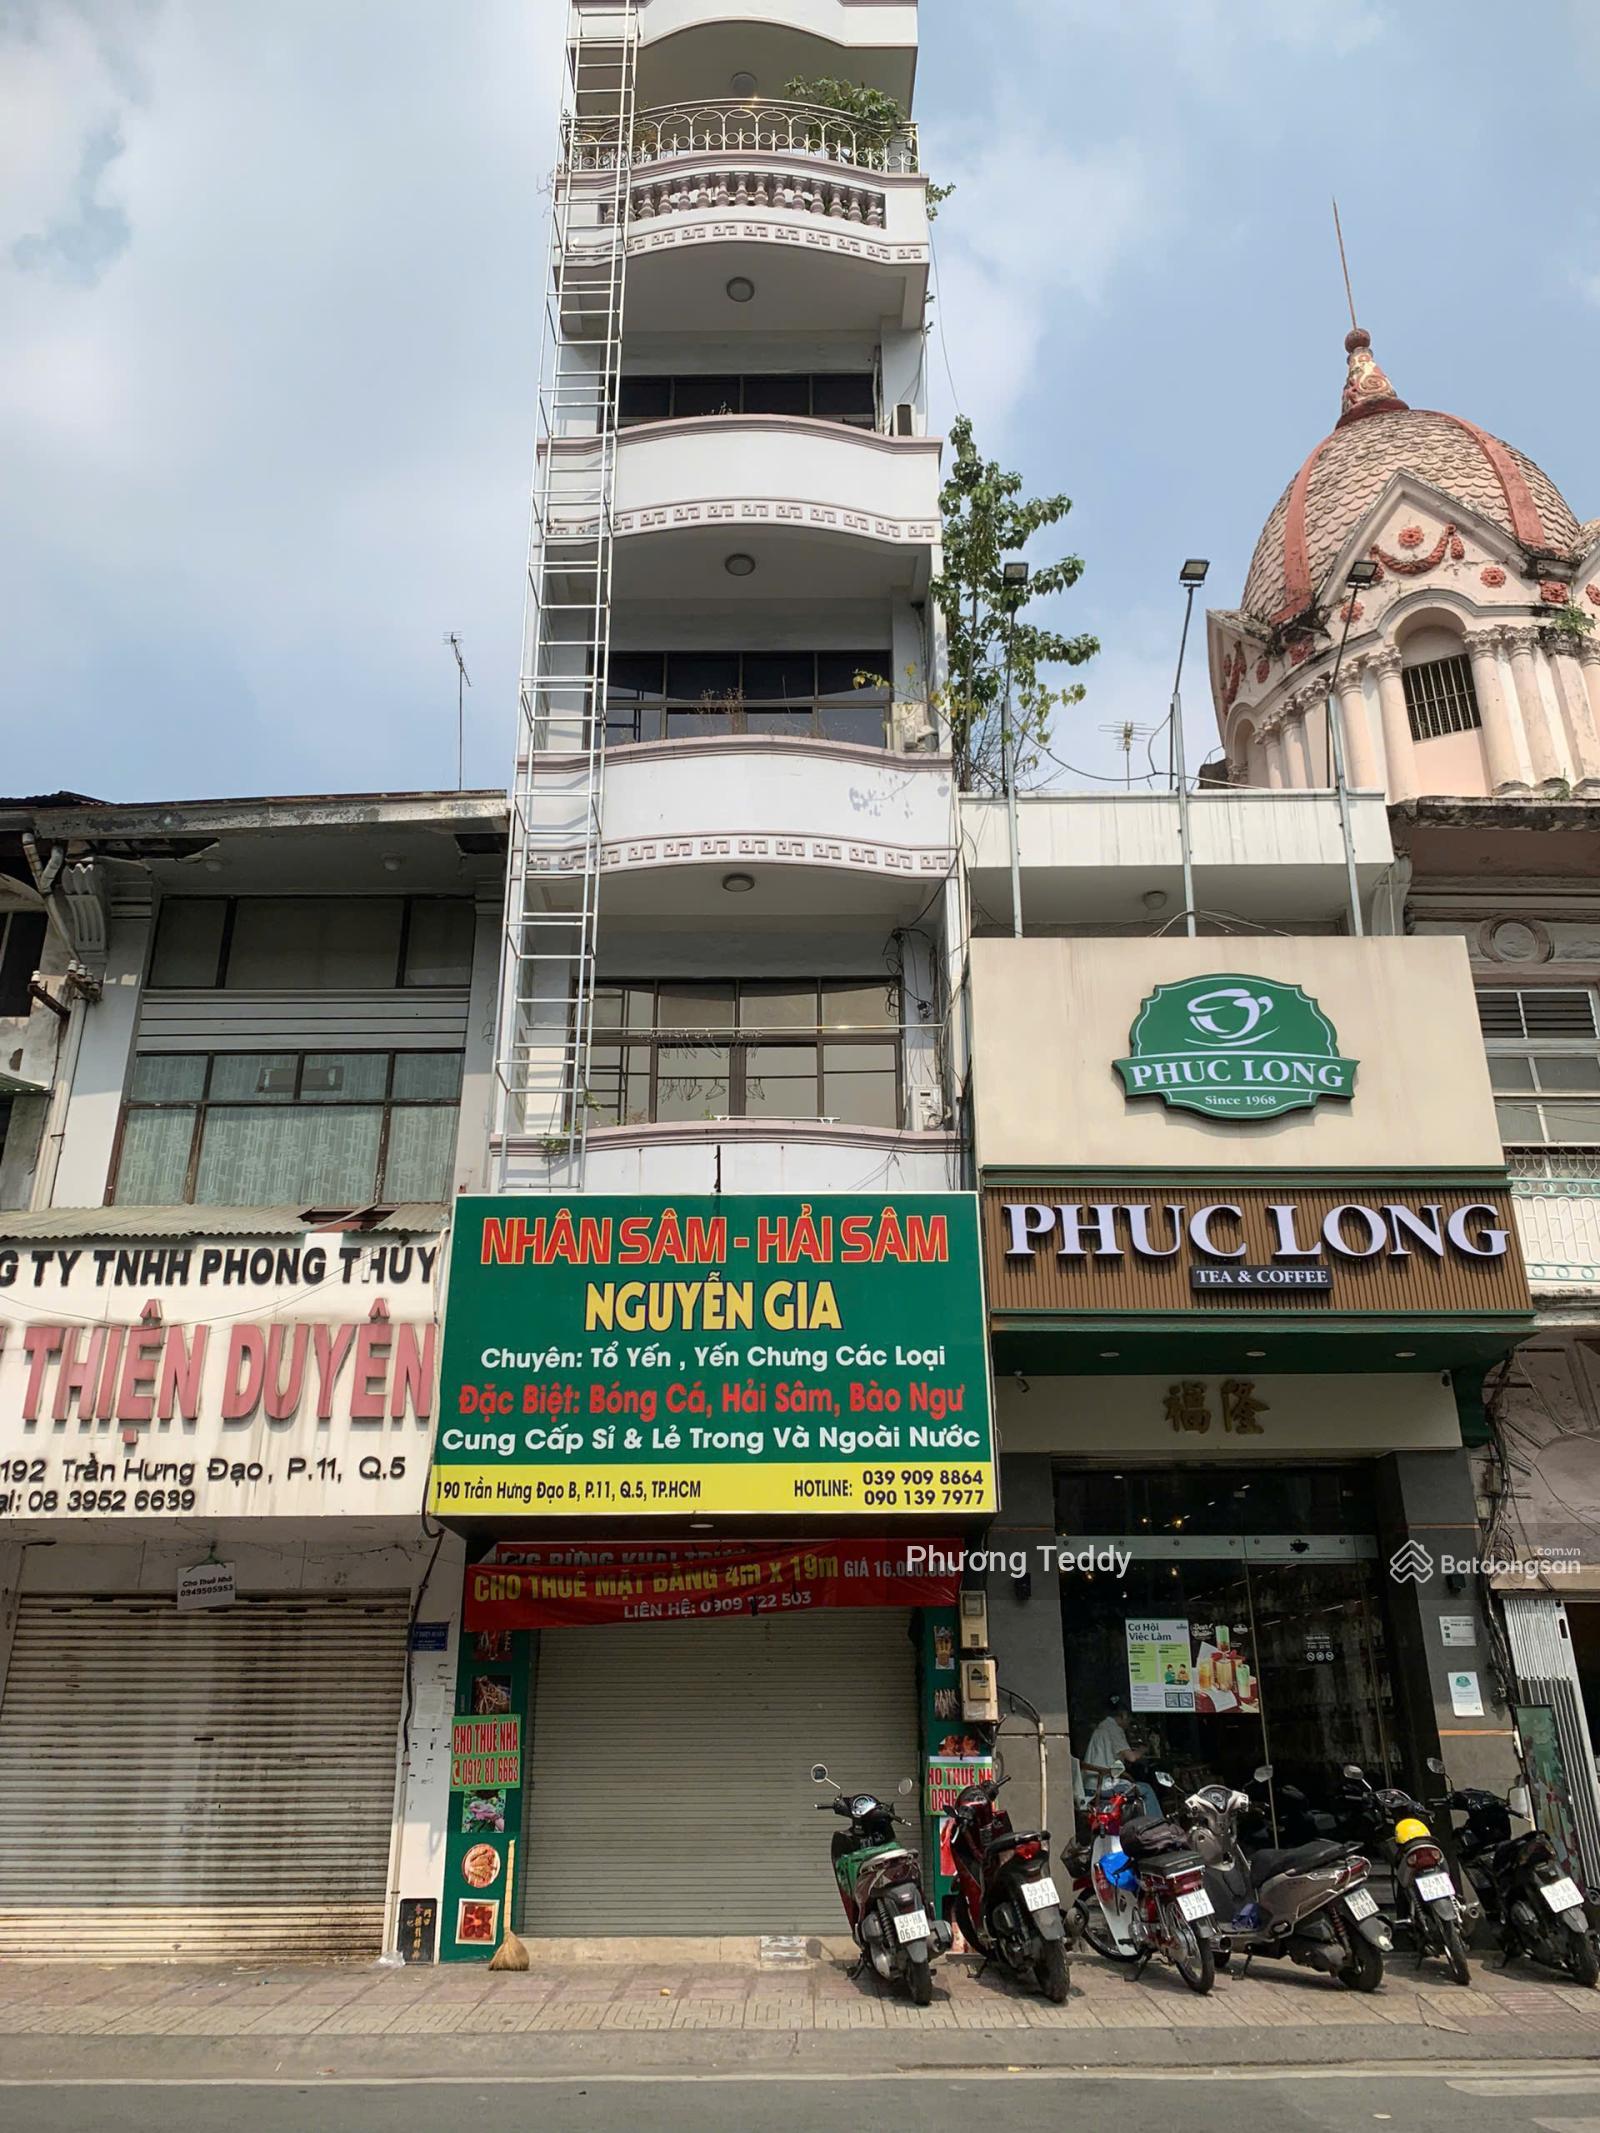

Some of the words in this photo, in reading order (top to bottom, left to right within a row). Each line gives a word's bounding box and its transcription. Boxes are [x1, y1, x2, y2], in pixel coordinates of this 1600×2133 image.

[1129, 1060, 1231, 1088] PHUC
[1241, 1060, 1345, 1088] LONG
[1205, 1095, 1240, 1105] Since
[1246, 1095, 1276, 1105] 1968
[480, 1208, 613, 1265] NHÂN
[619, 1208, 727, 1265] SÂM
[757, 1204, 833, 1264] HẢI
[840, 1206, 949, 1263] SÂM
[1003, 1203, 1247, 1258] PHUC
[1267, 1203, 1510, 1258] LONG
[31, 1249, 83, 1287] TY
[93, 1248, 194, 1287] TNHH
[200, 1247, 327, 1285] PHONG
[1196, 1269, 1233, 1285] TEA
[1237, 1270, 1253, 1284] &
[1256, 1269, 1329, 1284] COFFEE
[584, 1271, 754, 1333] NGUYỄN
[763, 1280, 844, 1332] GIA
[481, 1348, 584, 1372] Chuyên:
[591, 1341, 620, 1368] Tổ
[627, 1342, 672, 1368] Yến
[695, 1342, 739, 1367] Yến
[747, 1346, 828, 1372] Chưng
[836, 1344, 888, 1367] Các
[896, 1346, 946, 1371] Loại
[22, 1299, 210, 1444] THIỆN
[221, 1298, 437, 1420] DUYÊN
[458, 1383, 514, 1422] Đặc
[522, 1383, 580, 1422] Biệt:
[589, 1381, 657, 1422] Bóng
[665, 1381, 713, 1418] Cá,
[722, 1379, 766, 1413] Hải
[775, 1380, 841, 1418] Sâm,
[849, 1380, 901, 1413] Bào
[909, 1383, 966, 1421] Ngư
[442, 1429, 516, 1456] Cung
[524, 1424, 584, 1453] Cấp
[591, 1426, 617, 1450] Sỉ
[623, 1430, 643, 1450] &
[652, 1425, 682, 1449] Lẻ
[690, 1427, 764, 1454] Trong
[772, 1425, 810, 1449] Và
[819, 1425, 901, 1454] Ngoài
[909, 1424, 981, 1449] Nước
[0, 1459, 48, 1483] 192
[62, 1452, 116, 1483] Trần
[123, 1458, 197, 1487] Hưng
[287, 1457, 343, 1484] P.11,
[358, 1456, 407, 1481] Q.5
[863, 1470, 896, 1486] 039
[901, 1470, 934, 1485] 909
[939, 1469, 984, 1485] 8864
[28, 1490, 59, 1512] 08
[67, 1490, 127, 1512] 3952
[436, 1481, 461, 1500] 190
[464, 1476, 493, 1500] Trần
[496, 1481, 532, 1504] Hưng
[536, 1481, 565, 1504] Đạo
[585, 1480, 616, 1502] P.11,
[620, 1480, 648, 1502] Q.5,
[652, 1480, 701, 1499] TP.HCM
[794, 1479, 853, 1498] HOTLINE:
[864, 1490, 897, 1506] 090
[905, 1489, 936, 1505] 139
[942, 1488, 985, 1505] 7977
[474, 1574, 521, 1602] CHO
[528, 1570, 588, 1600] THUÊ
[768, 1562, 784, 1584] x
[790, 1553, 839, 1581] 19m
[843, 1556, 870, 1578] GIÁ
[623, 1601, 663, 1619] LIÊN
[782, 1591, 812, 1606] 503
[1143, 1622, 1160, 1632] Hội
[453, 1724, 473, 1755] CHO
[474, 1717, 498, 1754] THUÊ
[462, 1758, 482, 1785] 0912
[484, 1757, 496, 1784] 80
[945, 1764, 976, 1787] THUÊ
